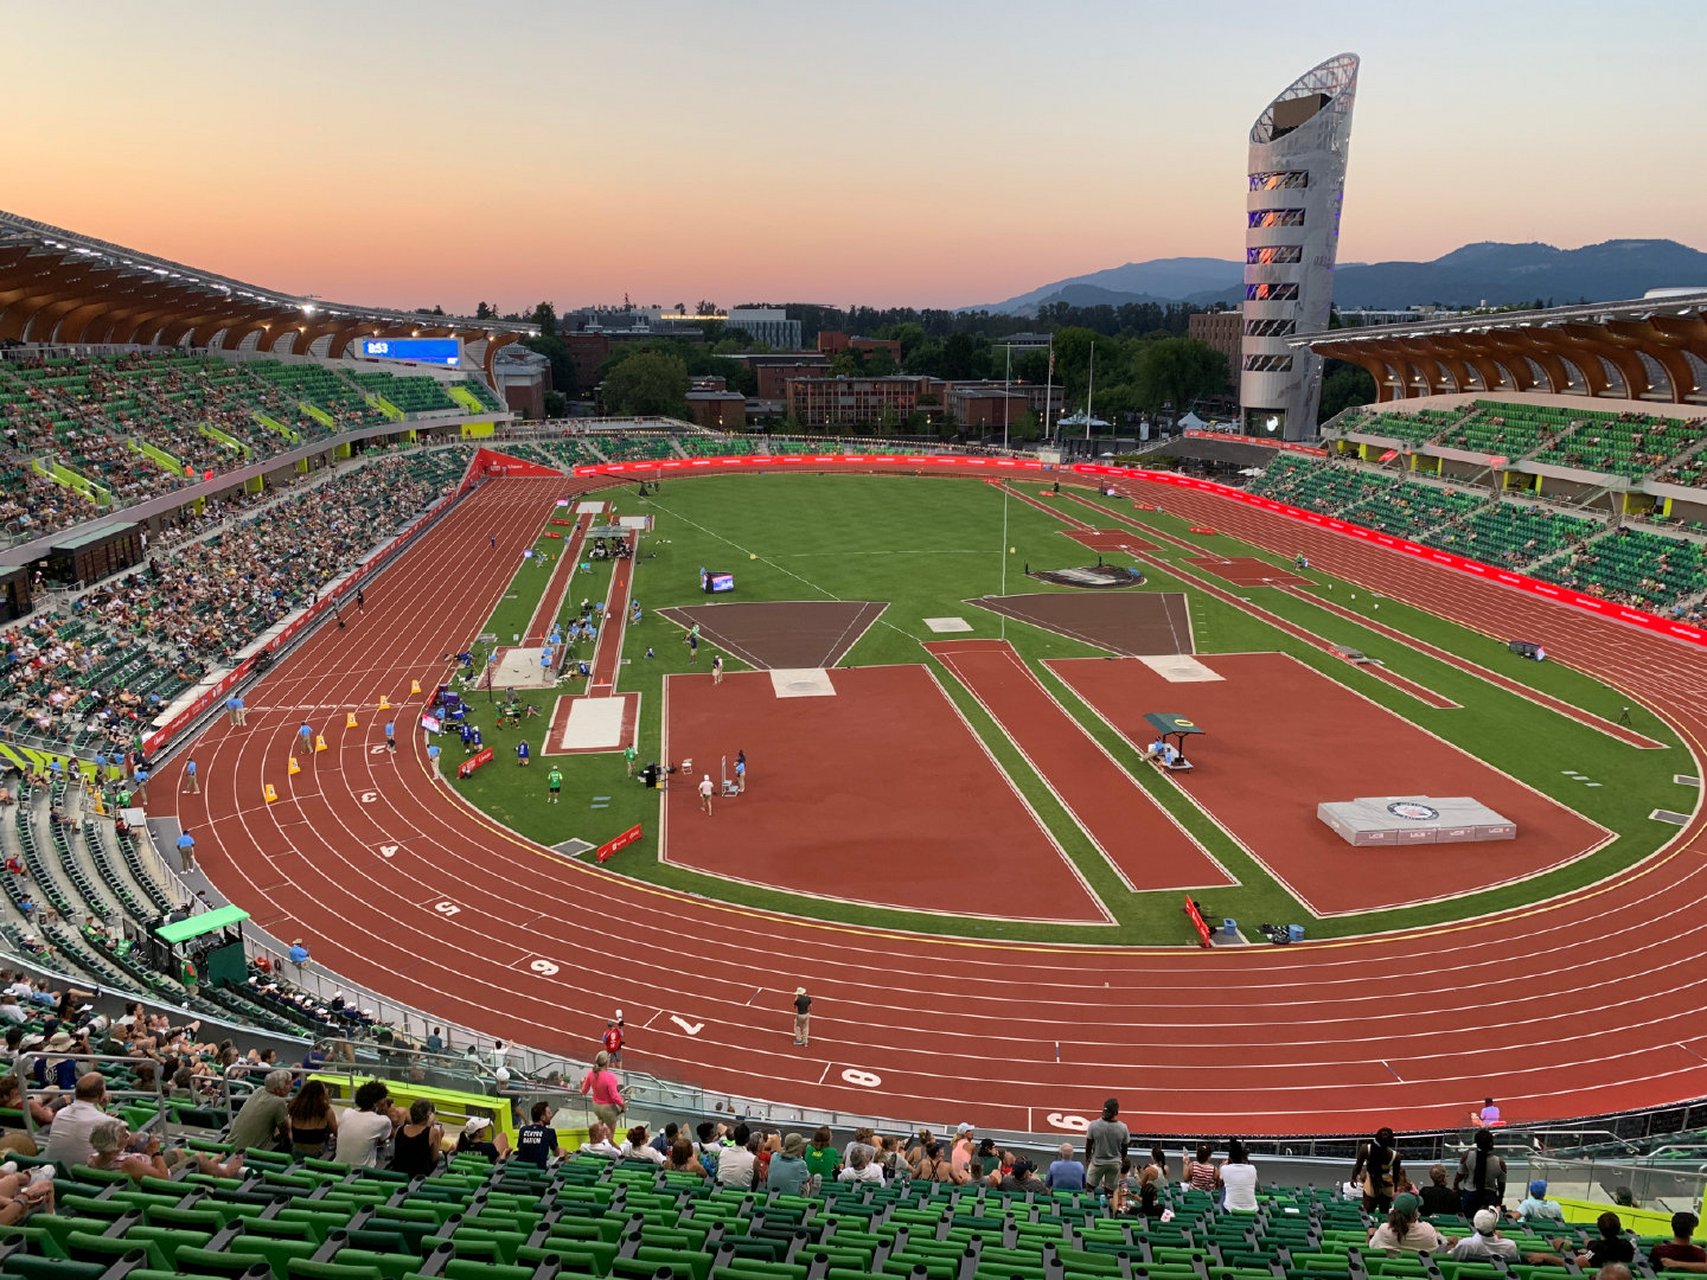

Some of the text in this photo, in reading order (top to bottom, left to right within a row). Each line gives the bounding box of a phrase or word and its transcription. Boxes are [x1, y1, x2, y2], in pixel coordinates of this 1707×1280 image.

[370, 744, 387, 754] 2
[361, 792, 377, 803] 3
[380, 845, 399, 858] 4
[434, 901, 461, 917] 5
[530, 959, 560, 976] 6
[670, 1015, 705, 1035] 7
[841, 1068, 882, 1088] 8
